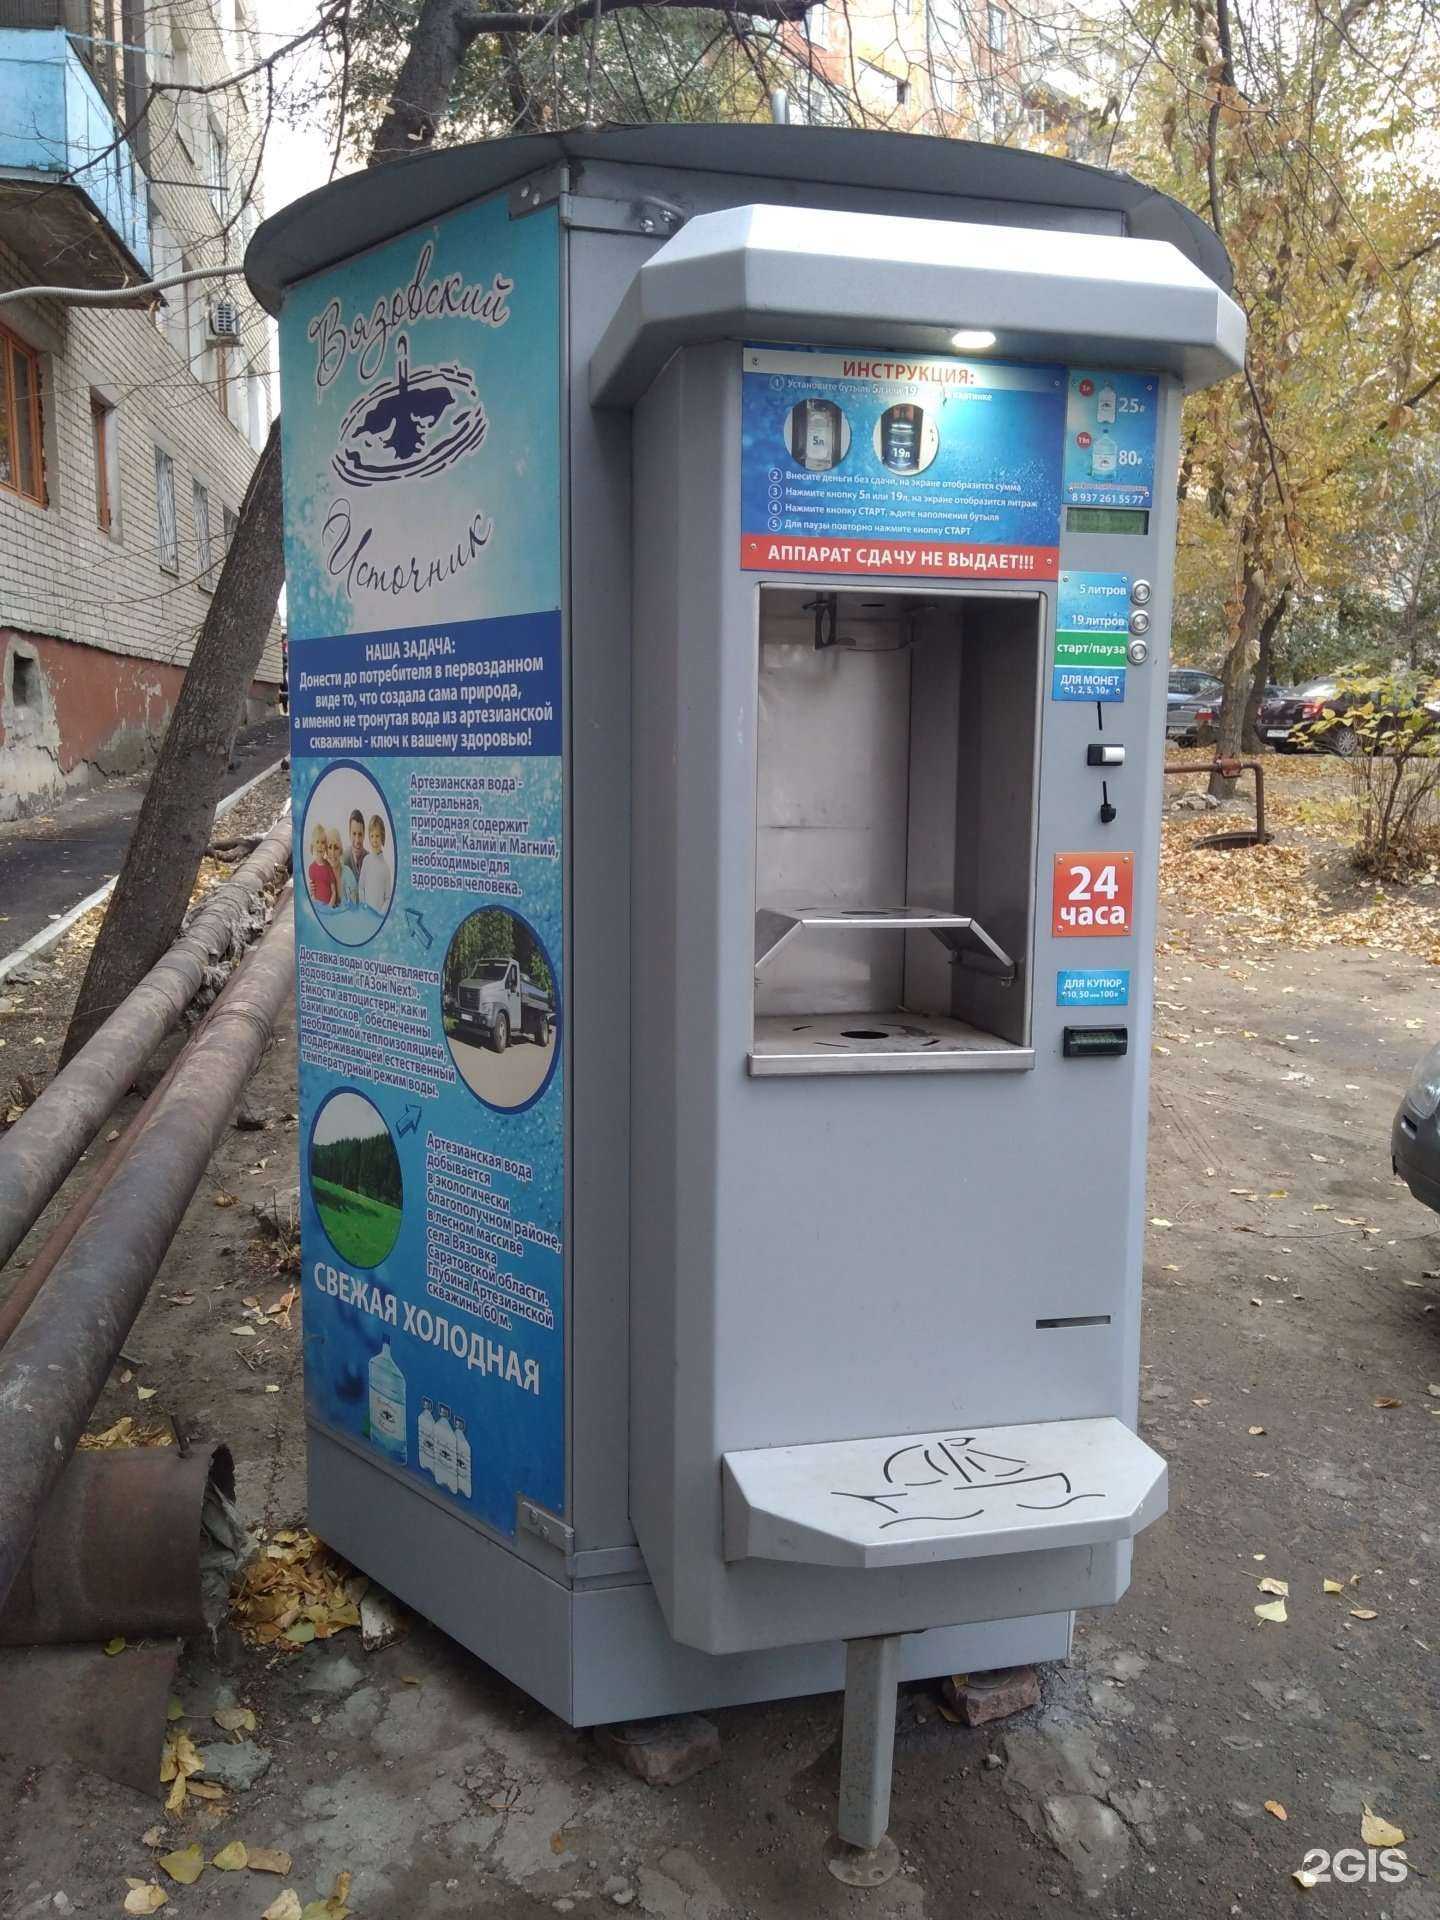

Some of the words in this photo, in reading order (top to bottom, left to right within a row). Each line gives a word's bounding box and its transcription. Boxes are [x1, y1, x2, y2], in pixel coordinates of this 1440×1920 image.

[310, 245, 511, 386] Вязовский
[843, 360, 974, 385] ИНСТРУКЦИЯ:
[787, 379, 837, 391] Установите
[839, 382, 870, 394] бутыль
[812, 436, 824, 446] 5л
[892, 447, 911, 458] 19л
[786, 471, 820, 481] Внесите
[822, 474, 853, 484] деньги
[855, 474, 868, 484] без
[912, 479, 940, 489] экране
[942, 480, 994, 490] отобразится
[995, 484, 1021, 493] сумма
[785, 488, 826, 498] Нажмите
[826, 490, 857, 500] кнопку
[859, 490, 870, 500] 5л
[923, 495, 952, 505] экране
[954, 496, 1006, 507] отобразится
[1007, 500, 1037, 510] литраж
[1072, 493, 1078, 502] 8
[1080, 493, 1097, 503] 937
[1099, 494, 1115, 503] 261
[1119, 495, 1130, 504] 55
[1132, 495, 1144, 504] 77
[785, 503, 825, 514] Нажмите
[826, 506, 857, 517] кнопку
[889, 510, 918, 518] ждите
[918, 511, 968, 520] наполнения
[970, 511, 1000, 522] бутыля
[785, 520, 802, 530] Для
[803, 521, 830, 531] паузы
[832, 522, 873, 533] повторно
[874, 525, 912, 534] нажмите
[913, 527, 944, 535] кнопку
[945, 526, 972, 536] СТАРТ
[321, 498, 491, 599] Источник
[768, 544, 850, 563] АППАРАТ
[856, 548, 917, 567] СДАЧУ
[921, 551, 943, 566] НЕ
[948, 553, 1034, 571] ВЫДАЕТ!!!
[1080, 583, 1087, 594] 5
[1087, 585, 1127, 597] литров
[1071, 614, 1084, 625] 19
[1085, 616, 1125, 628] литров
[365, 641, 401, 662] НАША
[403, 636, 456, 660] ЗАДАЧА:
[1056, 642, 1126, 656] старт/пауза
[299, 670, 342, 691] Донести
[344, 671, 358, 688] до
[359, 663, 433, 687] потребителя
[435, 665, 443, 679] в
[445, 656, 544, 681] первозданном
[1061, 674, 1082, 686] ДЛЯ
[1083, 675, 1120, 686] МОНЕТ
[315, 693, 341, 710] виде
[342, 693, 357, 709] то,
[359, 692, 378, 706] что
[380, 688, 426, 707] создала
[428, 686, 458, 702] сама
[460, 683, 522, 704] природа,
[294, 717, 301, 729] а
[302, 714, 341, 729] именно
[343, 714, 356, 728] не
[358, 712, 409, 731] тронутая
[411, 711, 440, 728] вода
[442, 709, 457, 724] из
[459, 700, 553, 728] артезианской
[309, 735, 363, 749] скважины
[370, 735, 400, 748] ключ
[402, 734, 409, 748] к
[410, 733, 458, 752] вашему
[460, 727, 532, 751] здоровью!
[410, 774, 485, 792] Артезианская
[487, 779, 516, 793] вода
[411, 795, 482, 813] натуральная,
[411, 815, 470, 832] природная
[472, 819, 529, 834] содержит
[411, 832, 459, 852] Кальций,
[462, 834, 497, 851] Калий
[499, 841, 507, 852] и
[509, 837, 559, 859] Магний,
[411, 853, 487, 874] необходимые
[488, 861, 510, 875] для
[411, 873, 463, 891] здоровья
[464, 879, 522, 896] человека.
[1068, 865, 1118, 901] 24
[1060, 905, 1126, 926] часа
[300, 946, 339, 965] Доставка
[339, 956, 362, 970] воды
[364, 960, 440, 984] осуществляется
[300, 966, 353, 985] водовозами
[1064, 978, 1085, 990] ДЛЯ
[1086, 978, 1122, 988] КУПЮР
[1080, 990, 1089, 998] 50
[300, 980, 337, 998] Емкости
[338, 990, 399, 1014] автоцистерн,
[401, 1003, 418, 1017] как
[419, 1008, 427, 1019] и
[300, 998, 322, 1013] баки
[365, 1012, 431, 1038] обеспеченны
[301, 1016, 361, 1041] необходимой
[361, 1031, 447, 1063] теплоизоляцией,
[302, 1033, 382, 1063] поддерживающей
[384, 1053, 455, 1083] естественный
[302, 1050, 372, 1077] температурный
[373, 1070, 407, 1087] режим
[408, 1079, 439, 1097] воды.
[427, 1132, 502, 1169] Артезианская
[504, 1160, 533, 1180] вода
[426, 1154, 491, 1185] добывается
[427, 1172, 434, 1184] в
[435, 1174, 510, 1211] экологически
[427, 1187, 513, 1231] благополучном
[513, 1222, 561, 1253] районе,
[427, 1209, 434, 1221] в
[435, 1211, 475, 1236] лесном
[476, 1227, 523, 1256] массиве
[427, 1227, 450, 1246] села
[452, 1233, 497, 1264] Вязовка
[427, 1242, 496, 1284] Саратовской
[498, 1272, 550, 1305] области.
[427, 1261, 470, 1291] Глубина
[472, 1279, 554, 1328] Артезианской
[427, 1282, 482, 1317] скважины
[483, 1301, 497, 1320] 60
[499, 1315, 513, 1330] м.
[313, 1261, 397, 1327] СВЕЖАЯ
[402, 1300, 540, 1395] ХОЛОДНАЯ
